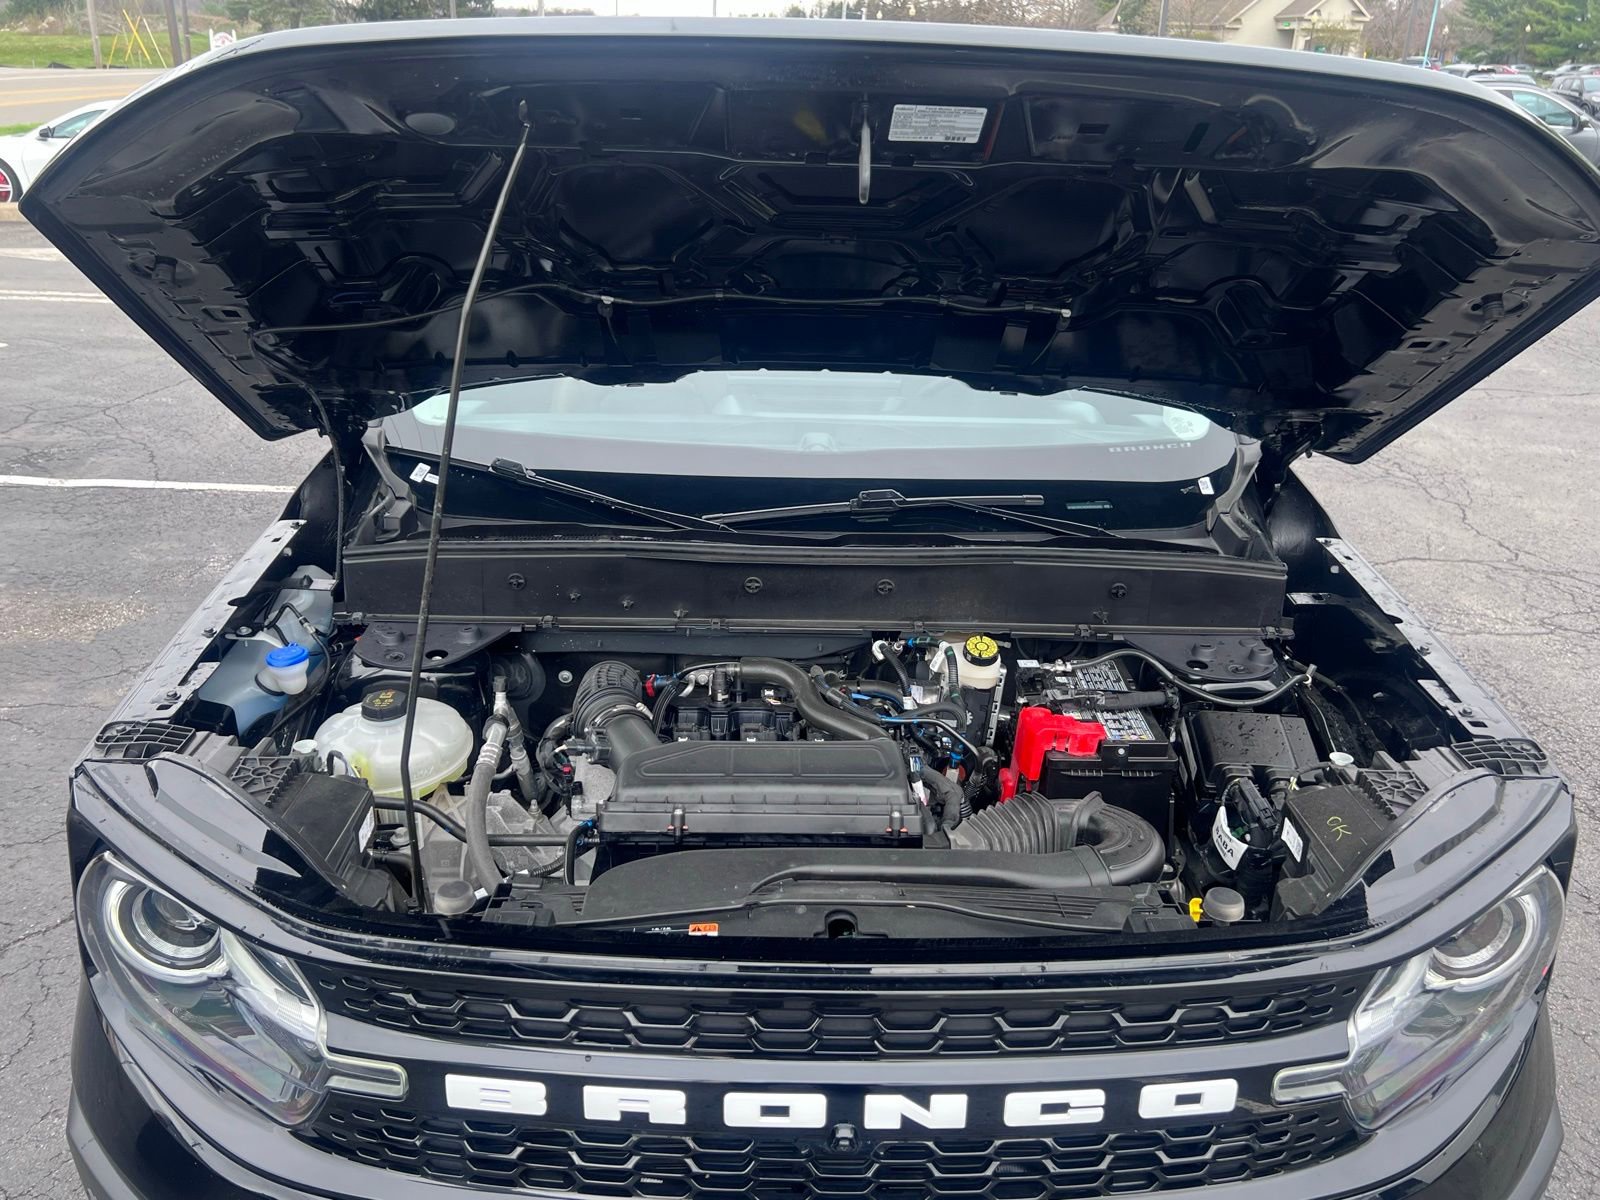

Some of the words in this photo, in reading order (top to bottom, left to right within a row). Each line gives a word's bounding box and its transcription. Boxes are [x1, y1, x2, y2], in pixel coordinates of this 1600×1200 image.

[1108, 442, 1191, 453] BRONCO
[1326, 816, 1352, 841] OK
[445, 1073, 1239, 1130] BRONCO
